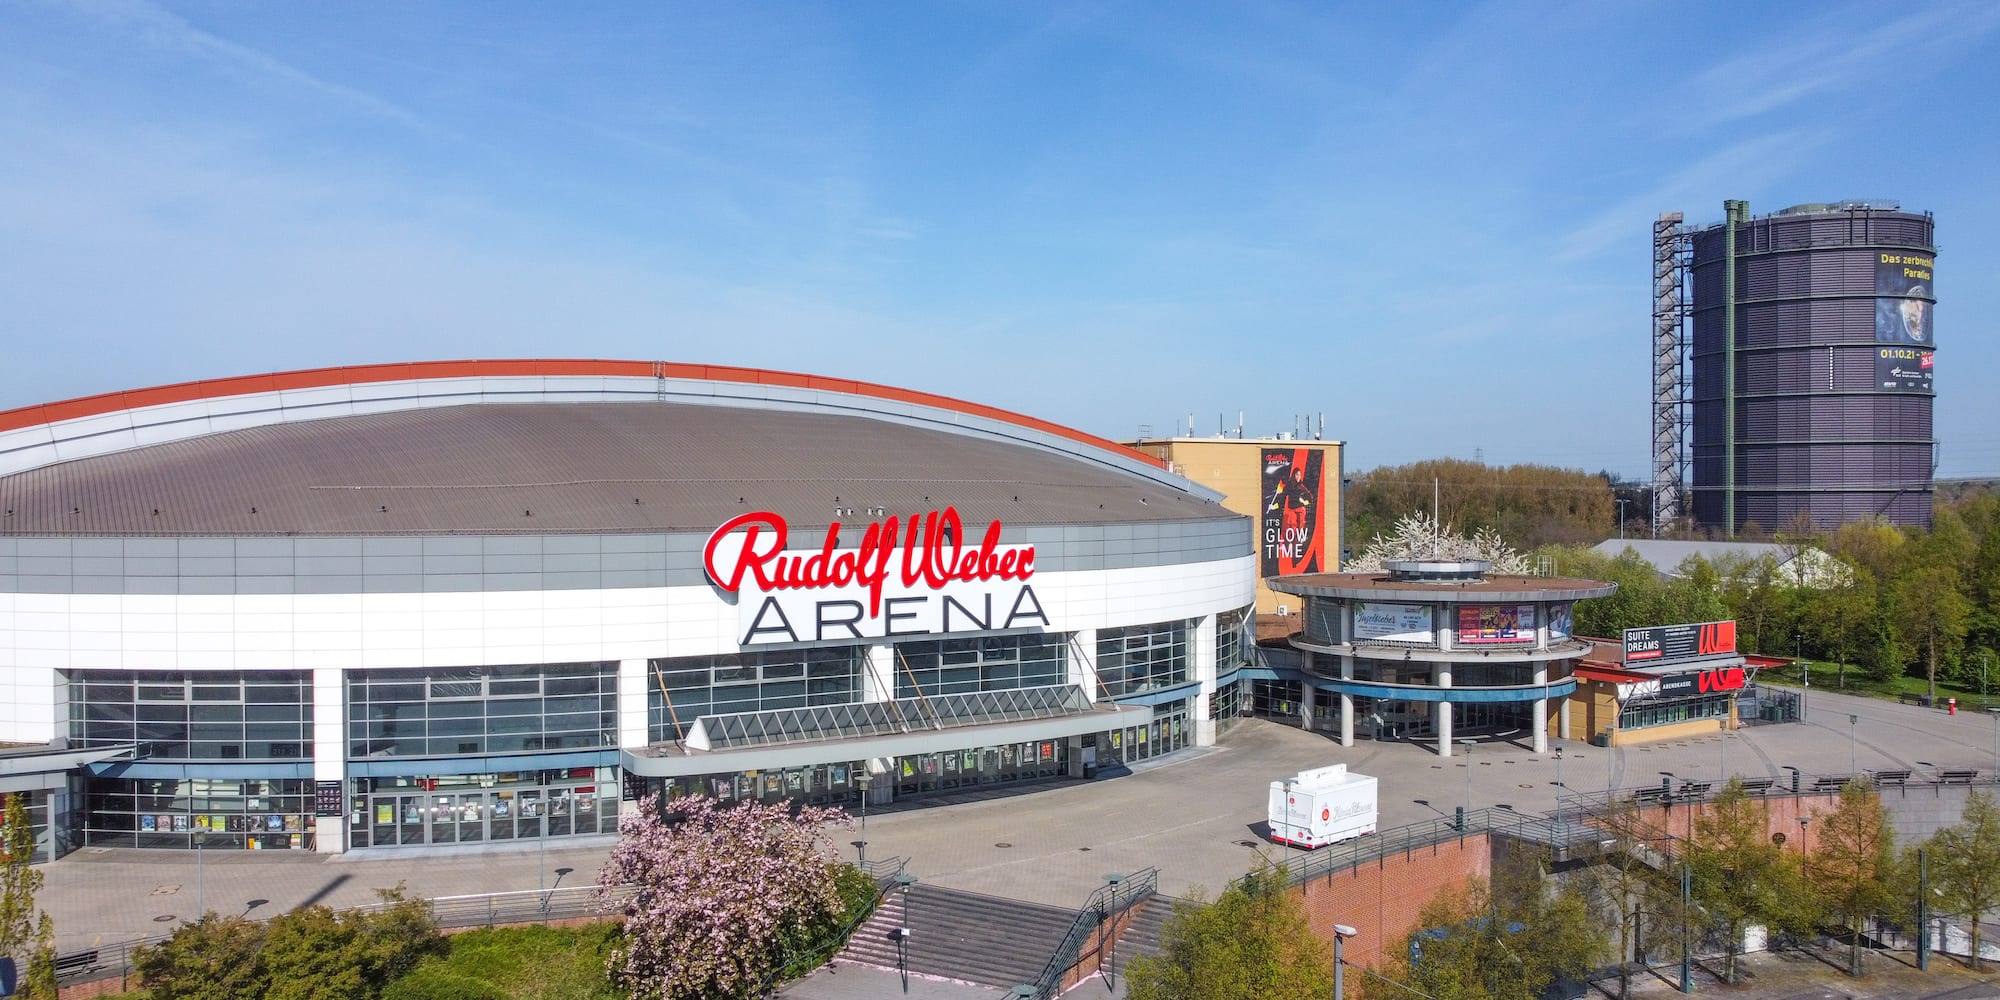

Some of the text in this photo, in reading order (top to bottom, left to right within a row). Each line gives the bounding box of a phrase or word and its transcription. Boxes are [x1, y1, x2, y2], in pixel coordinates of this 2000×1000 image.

[1881, 254, 1901, 264] Das
[1881, 350, 1915, 359] 01.10.21
[1266, 519, 1280, 527] IT'S
[1266, 528, 1308, 543] GLOW
[1265, 543, 1303, 559] TIME
[703, 505, 1036, 619] Rudolf Weber
[742, 584, 1051, 646] ARENA
[1627, 631, 1650, 641] SUITE
[1627, 640, 1660, 651] DREAMS
